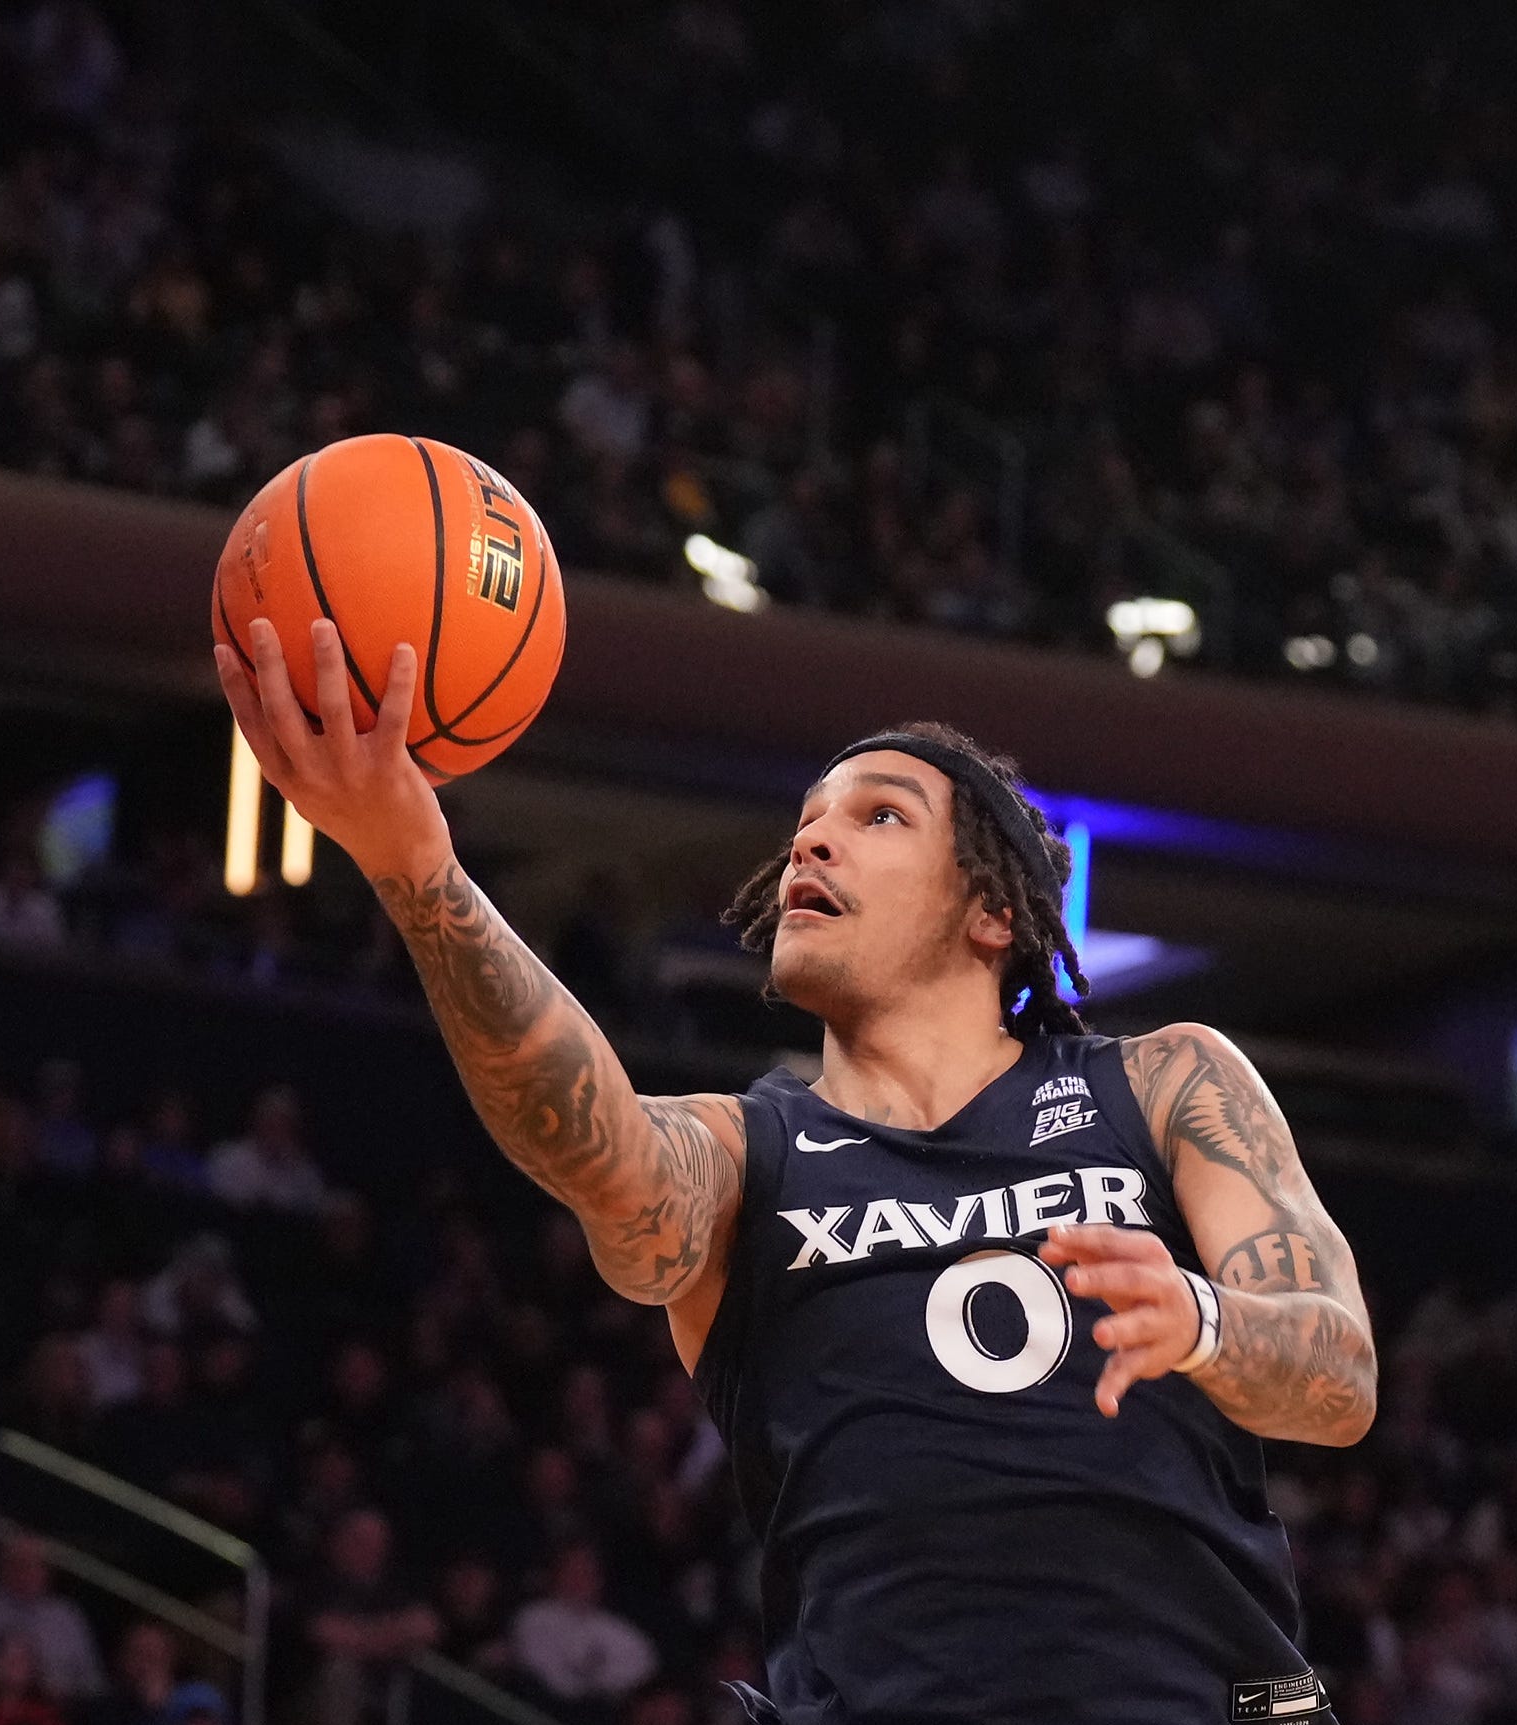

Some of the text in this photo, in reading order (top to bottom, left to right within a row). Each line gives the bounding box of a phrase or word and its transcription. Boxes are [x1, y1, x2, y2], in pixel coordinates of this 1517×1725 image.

[1031, 1085, 1092, 1106] CHANGE
[1035, 1076, 1089, 1097] BE THE
[1032, 1109, 1098, 1139] EAST
[1036, 1100, 1081, 1125] BIG
[776, 1166, 1155, 1271] XAVIER
[1238, 1705, 1267, 1714] TEAM
